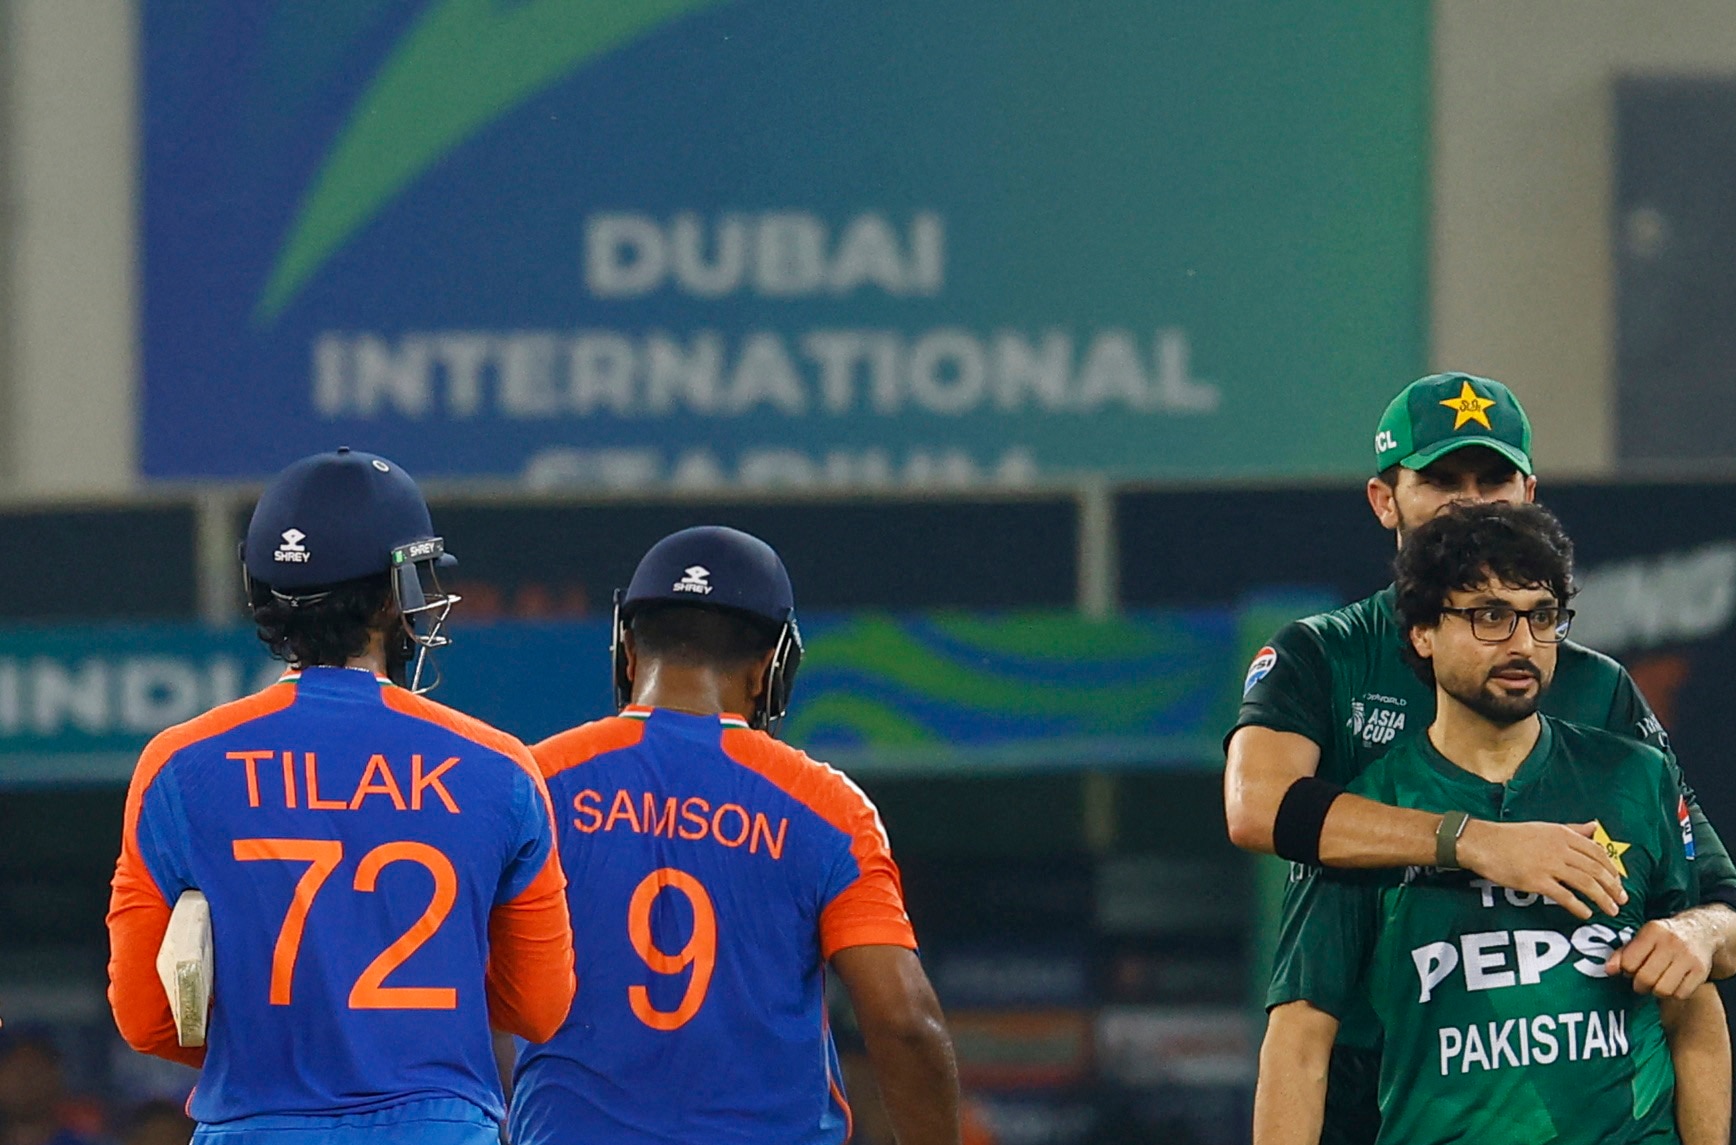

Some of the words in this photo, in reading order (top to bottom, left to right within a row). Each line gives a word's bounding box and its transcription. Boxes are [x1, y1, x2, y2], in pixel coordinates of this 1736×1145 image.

[584, 212, 944, 298] DUBAI
[312, 328, 1220, 416] INTERNATIONAL
[274, 551, 311, 563] SHREY
[409, 542, 435, 557] SHREY
[672, 581, 713, 595] SHREY
[0, 654, 285, 736] INDI
[1368, 708, 1406, 730] ASIA
[1362, 723, 1396, 744] CUP
[226, 750, 462, 813] TILAK
[573, 790, 789, 860] SAMSON
[232, 838, 457, 1010] 72
[1470, 879, 1559, 908] TC
[627, 867, 718, 1031] 9
[1411, 923, 1635, 1004] PEPS
[1439, 1009, 1630, 1076] PAKISTAN
